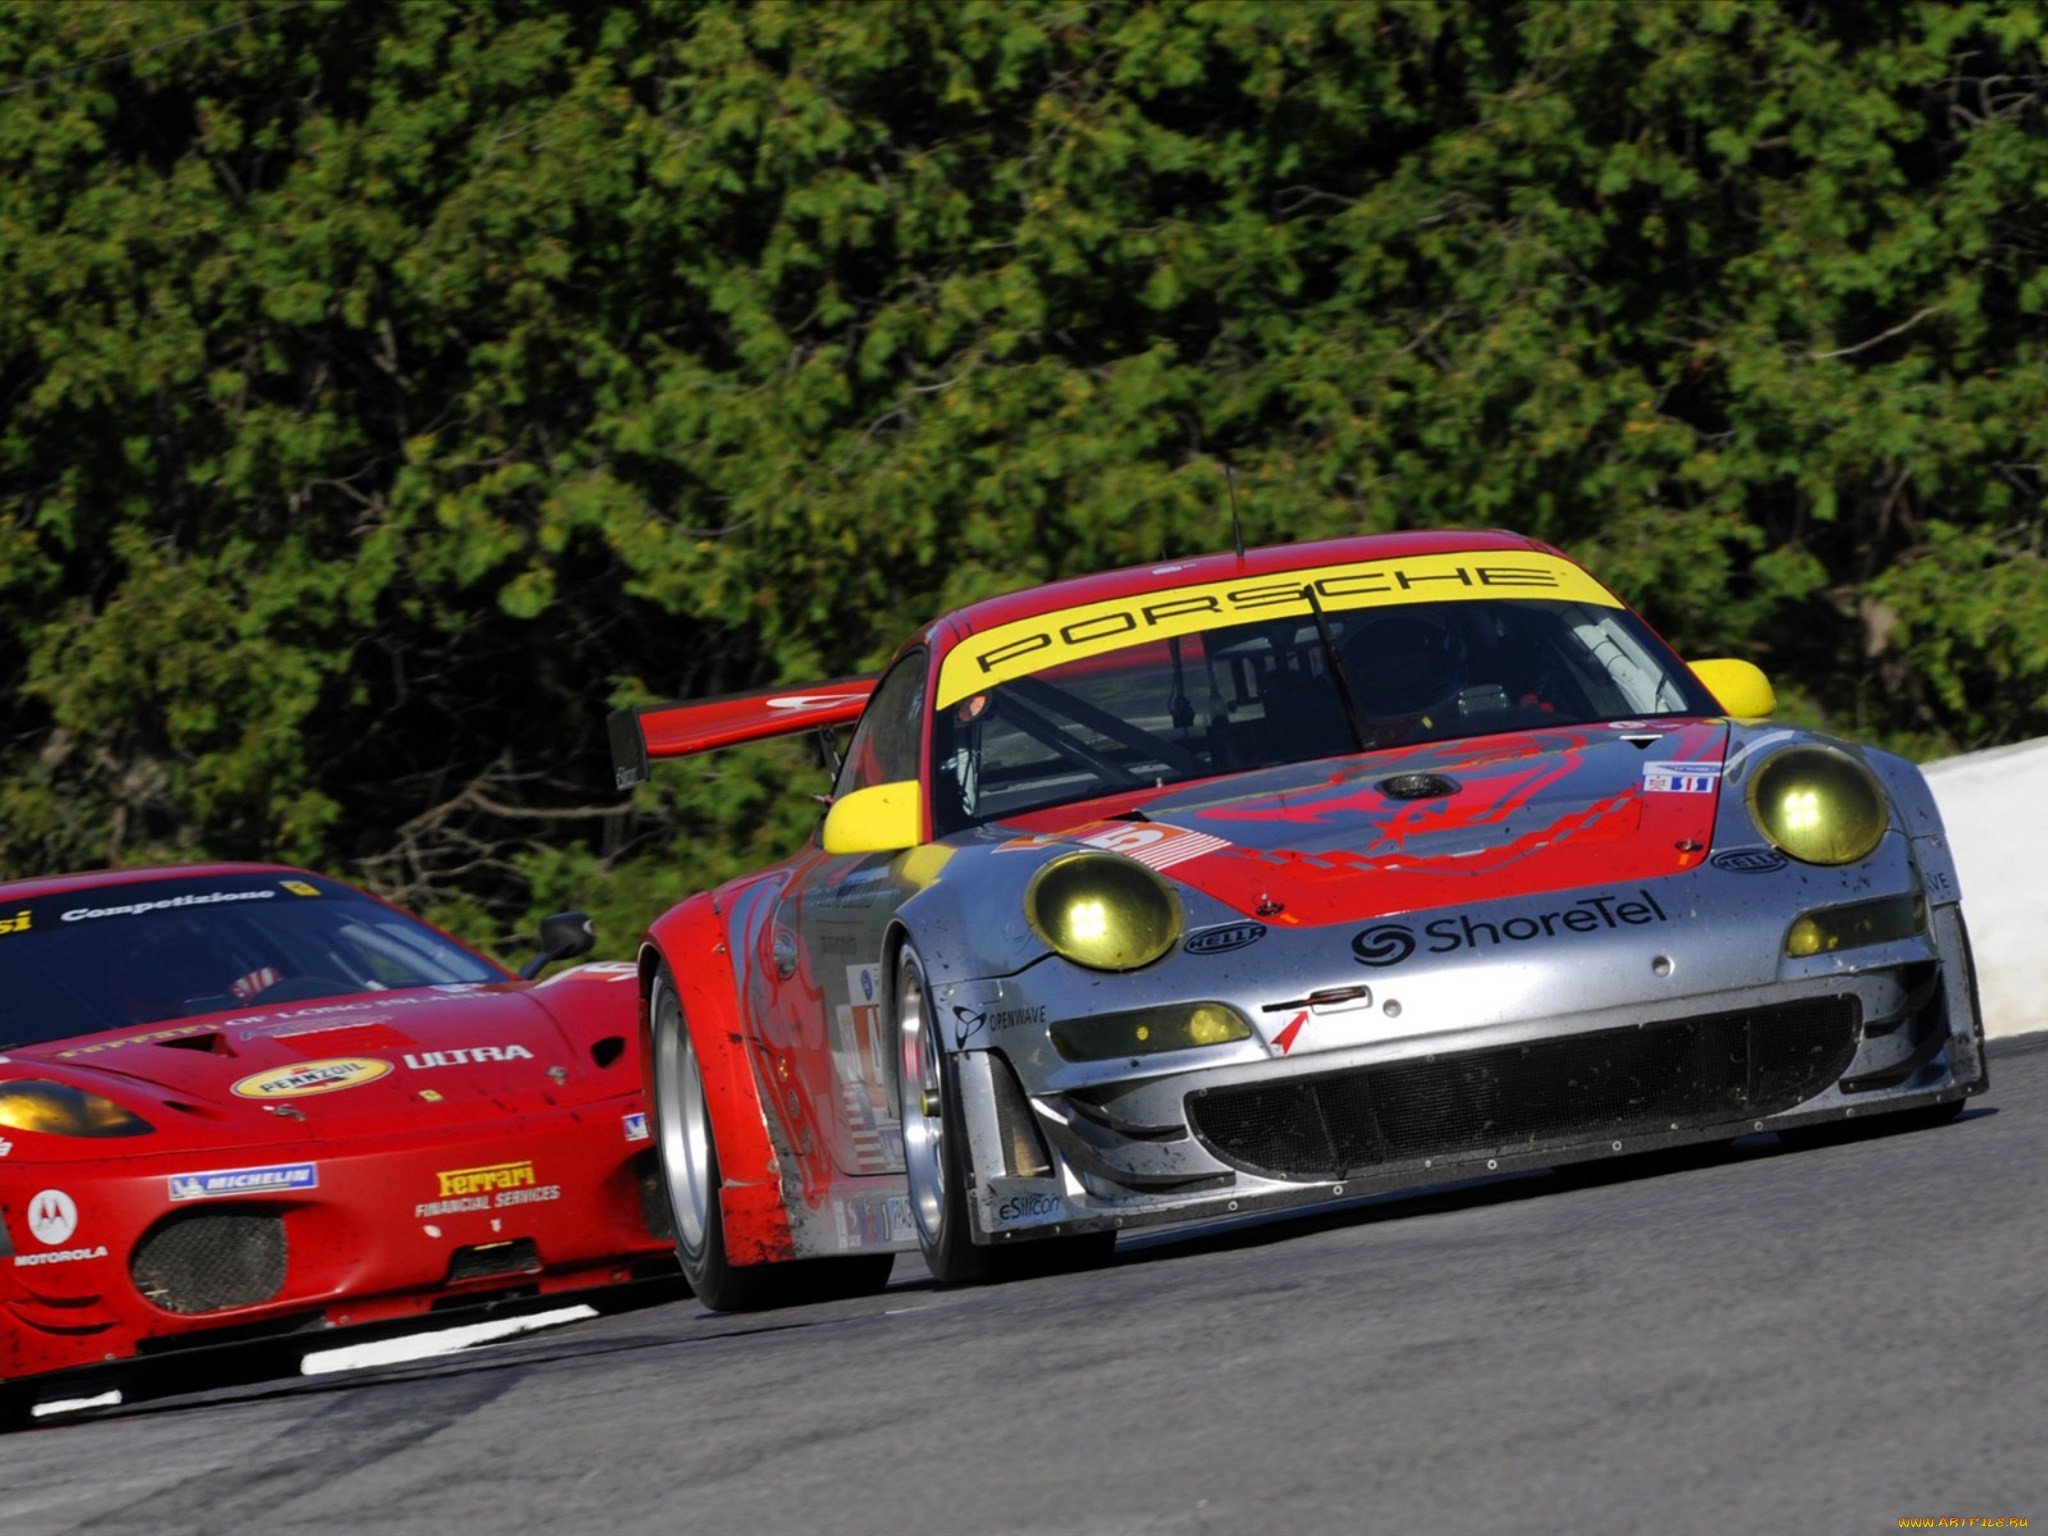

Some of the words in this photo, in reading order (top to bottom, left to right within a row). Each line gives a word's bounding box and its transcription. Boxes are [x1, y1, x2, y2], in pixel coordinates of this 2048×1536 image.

[976, 566, 1559, 674] PORSCHE
[61, 890, 276, 921] Competizione
[1424, 890, 1667, 953] ShoreTel
[1188, 926, 1267, 950] HELLA
[989, 1004, 1047, 1032] OPENWAVE
[403, 1045, 535, 1070] ULTRA
[259, 1062, 366, 1093] PENNZOIL
[206, 1169, 311, 1190] MICHELIN
[437, 1160, 536, 1197] Ferrari
[415, 1195, 491, 1218] FINANCIAL
[494, 1185, 561, 1208] SERVICES
[999, 1195, 1061, 1220] eSilicon
[14, 1245, 108, 1267] MOTOROLA
